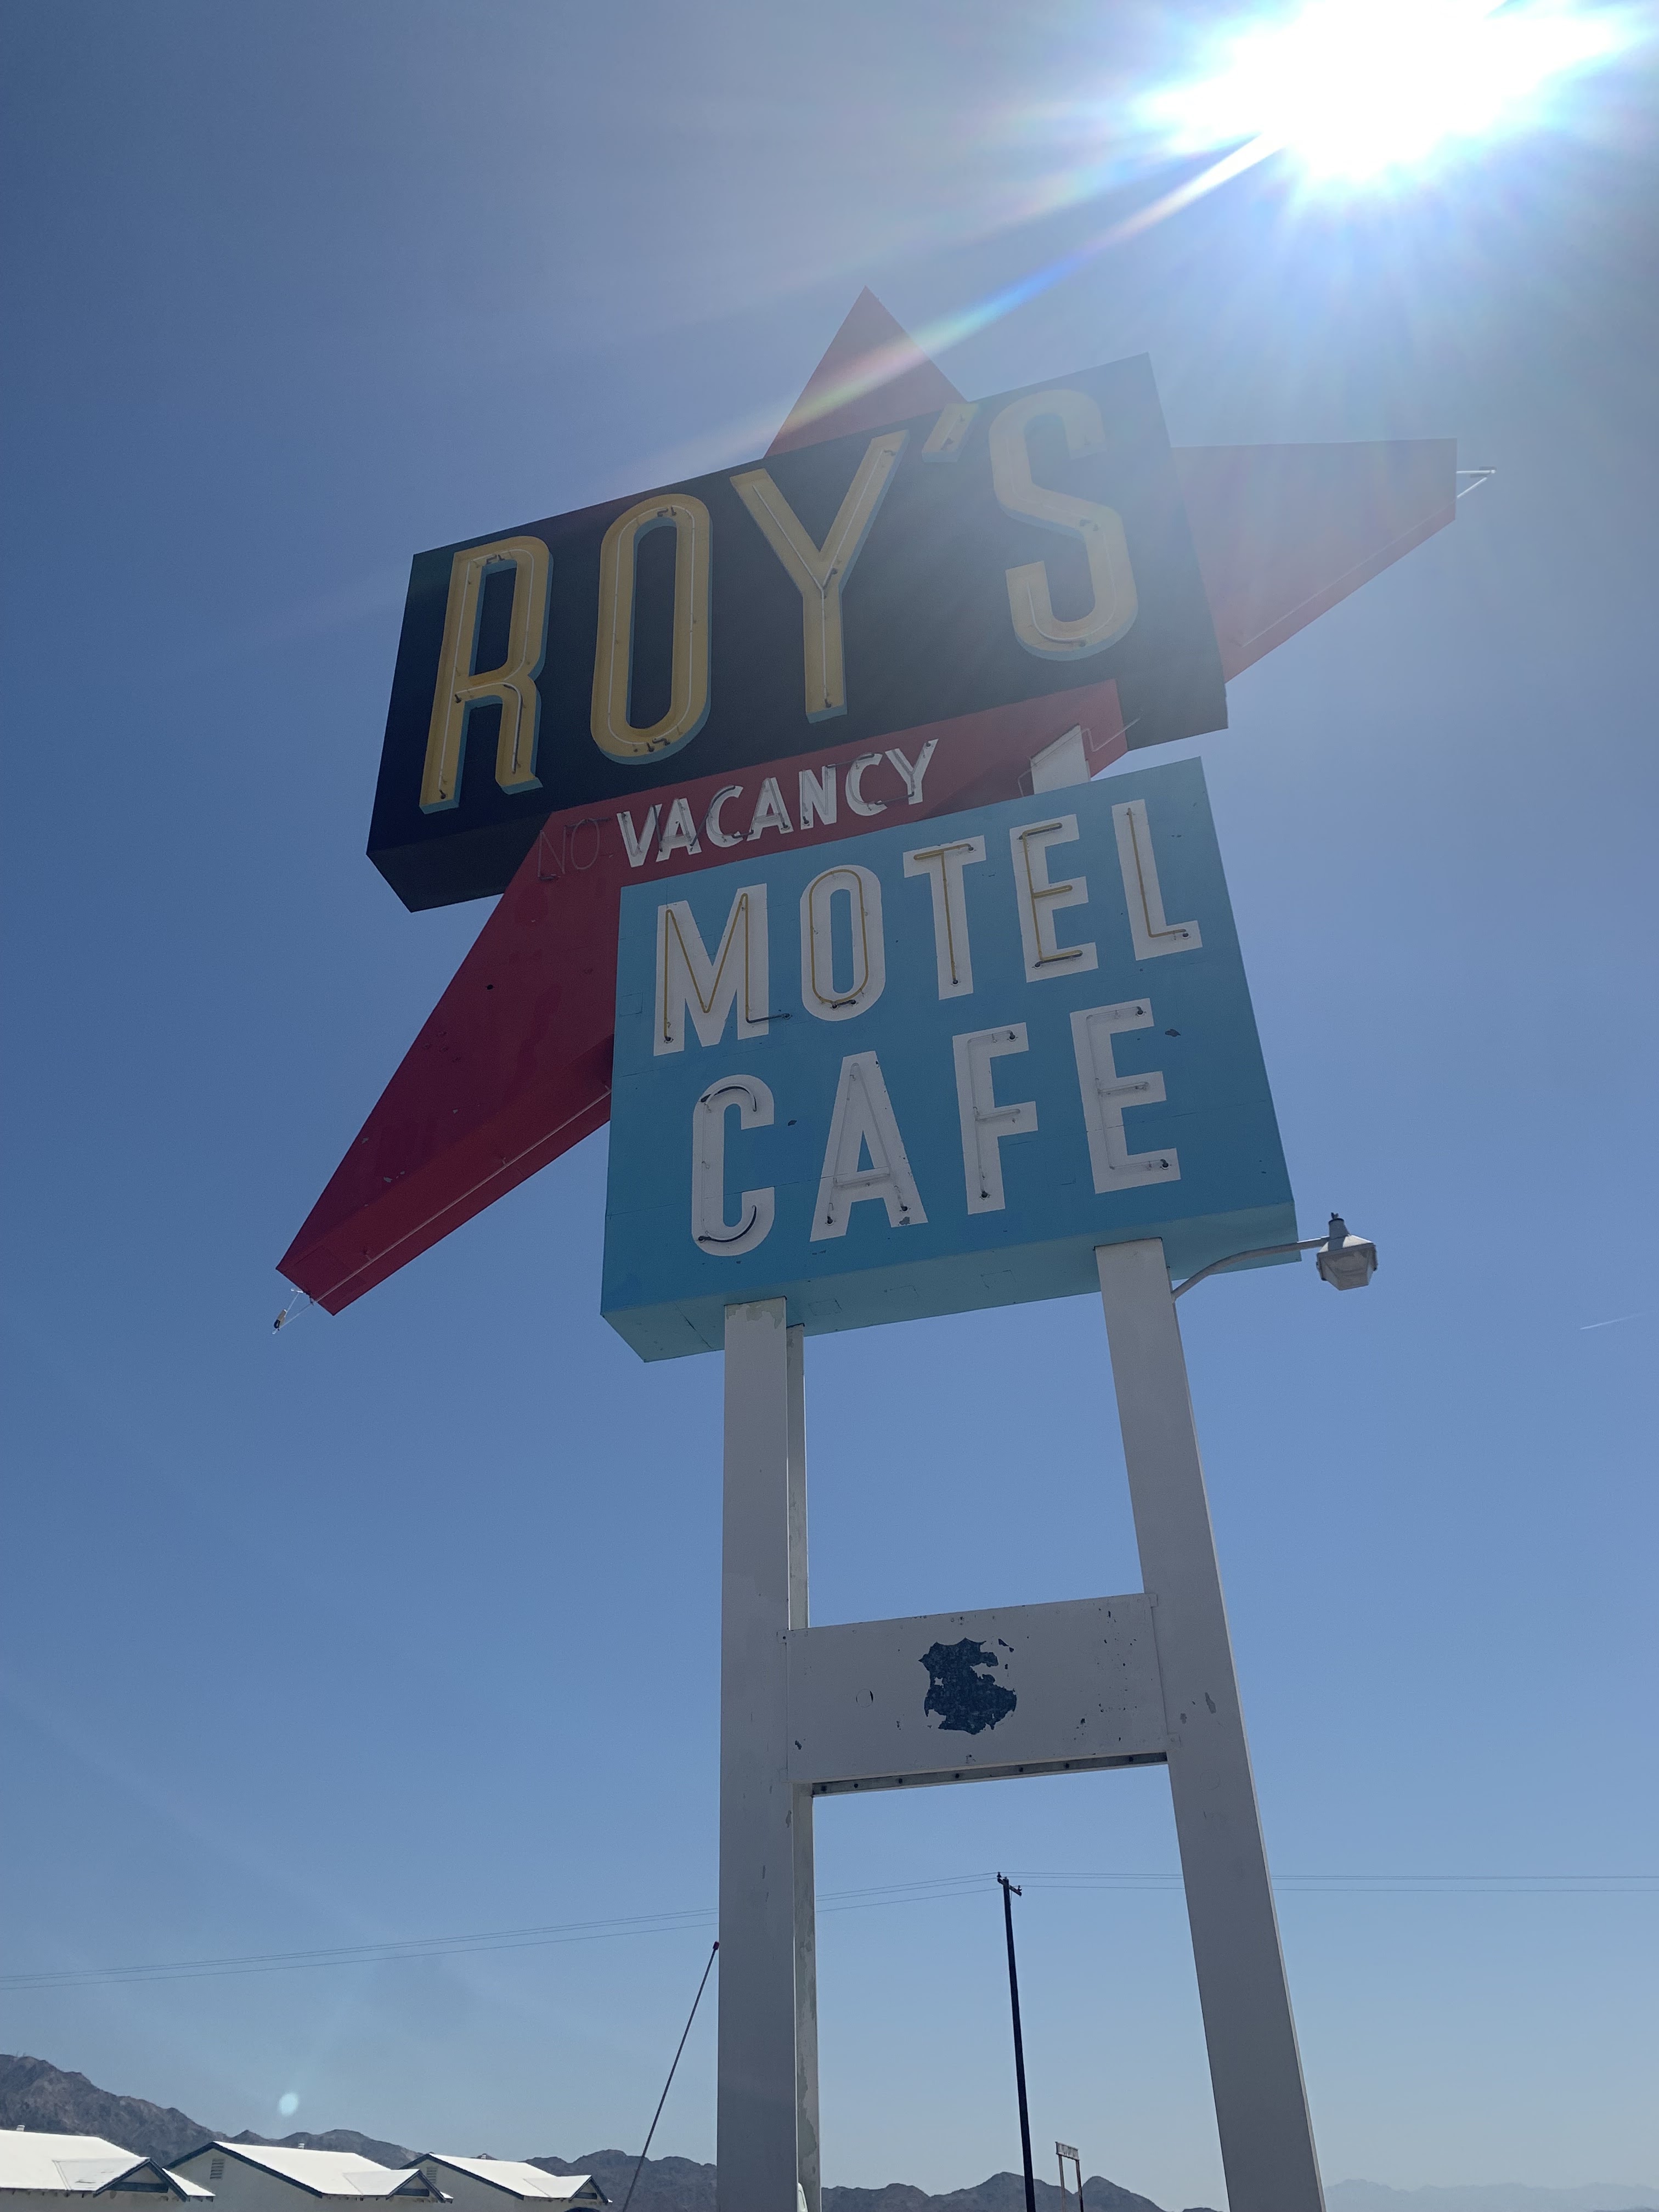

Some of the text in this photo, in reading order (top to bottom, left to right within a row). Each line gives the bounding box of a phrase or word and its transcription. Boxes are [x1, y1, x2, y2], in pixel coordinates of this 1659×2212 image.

[419, 389, 1138, 814] ROY'S
[537, 738, 939, 880] NO VACANCY
[653, 799, 1203, 1057] MOTEL
[691, 997, 1182, 1256] CAFE
